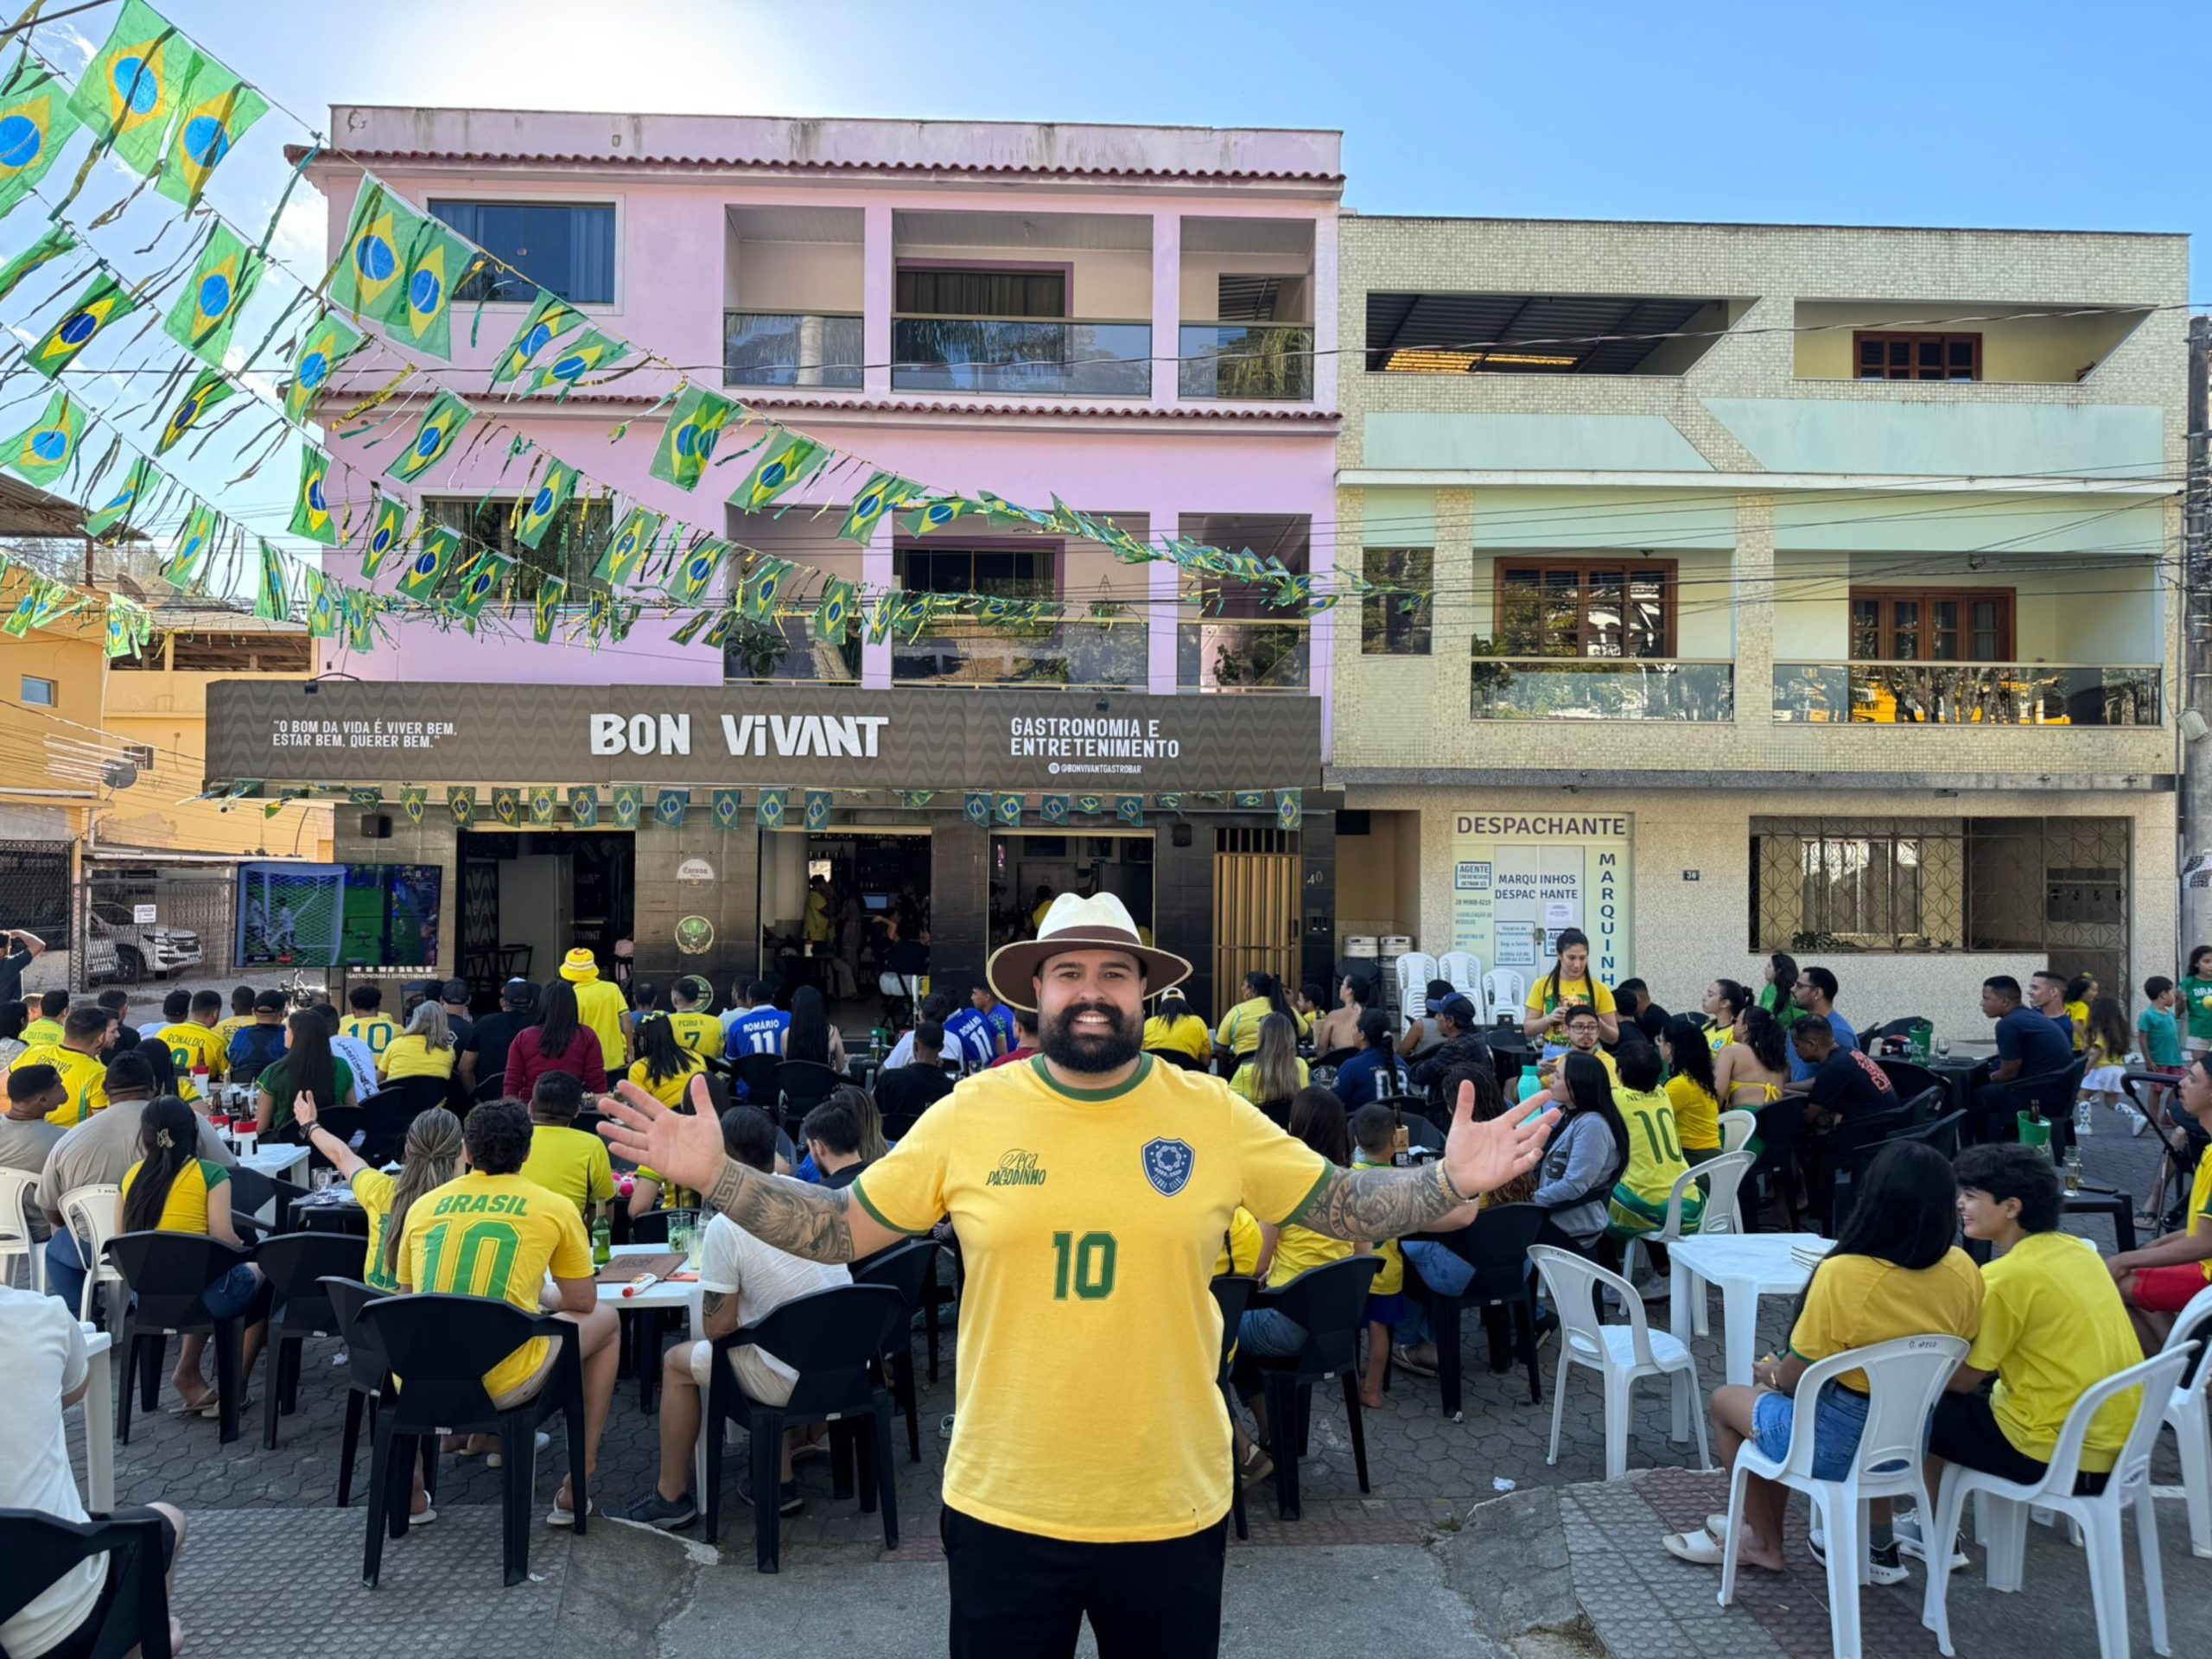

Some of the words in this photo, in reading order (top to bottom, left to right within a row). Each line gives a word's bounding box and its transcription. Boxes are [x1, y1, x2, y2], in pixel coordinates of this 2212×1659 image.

[292, 721, 318, 734] BOM
[322, 721, 338, 734] DA
[342, 721, 370, 734] VIDA
[374, 718, 382, 734] É
[387, 721, 423, 734] VIVER
[590, 713, 690, 755] BON
[1010, 717, 1141, 737] GASTRONOMIA
[1148, 720, 1160, 737] E
[273, 734, 311, 746] ESTAR
[315, 734, 346, 747] BEM,
[350, 735, 398, 748] QUERER
[1010, 738, 1179, 758] ENTRETENIMENTO
[1061, 763, 1142, 773] @BONVIVANTGASTROBAR
[1457, 817, 1625, 835] DESPACHANTE
[1306, 871, 1323, 885] 40
[1599, 854, 1615, 985] MARQUINH
[167, 1033, 205, 1048] RONALDO
[347, 1022, 393, 1053] 10
[684, 1031, 701, 1051] 7
[750, 1030, 776, 1054] 11
[969, 1026, 994, 1066] 11
[1633, 1107, 1681, 1164] 10
[986, 1167, 1046, 1186] PAGODINHO
[433, 1193, 528, 1217] BRASIL
[422, 1219, 522, 1300] 10
[1052, 1231, 1118, 1300] 10
